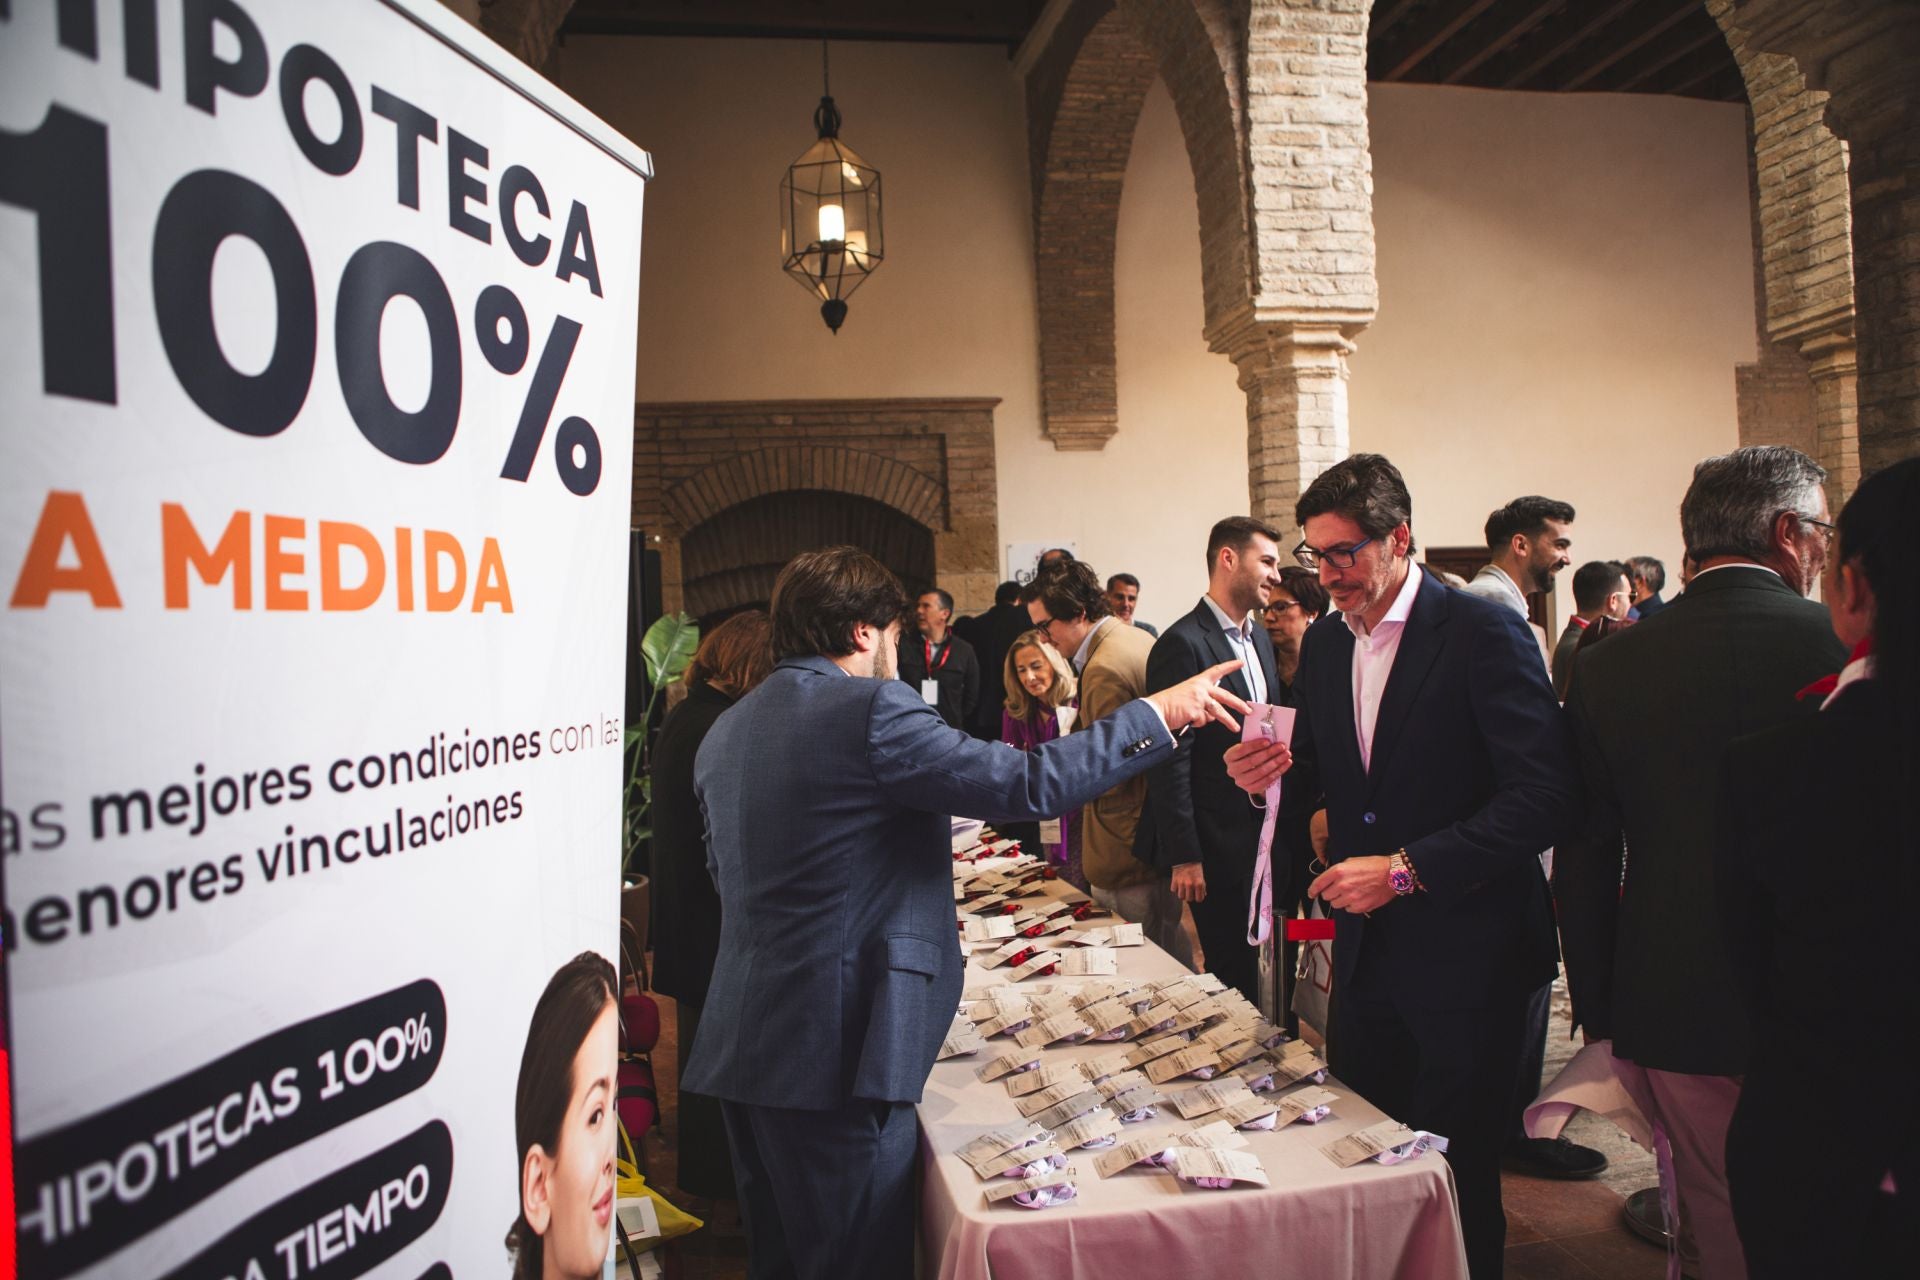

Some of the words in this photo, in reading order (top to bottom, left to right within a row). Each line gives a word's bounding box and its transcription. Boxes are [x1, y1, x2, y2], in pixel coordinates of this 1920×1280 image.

[0, 101, 602, 497] 100%
[10, 490, 123, 610] A
[161, 502, 514, 615] MEDIDA
[0, 802, 67, 853] as
[90, 763, 312, 838] mejores
[328, 727, 541, 796] condiciones
[549, 723, 593, 755] con
[599, 711, 620, 746] las
[256, 786, 524, 884] vinculaciones
[18, 1067, 301, 1243] HIPOTECAS
[317, 1011, 433, 1102] 100%
[274, 1163, 431, 1280] TIEMPO
